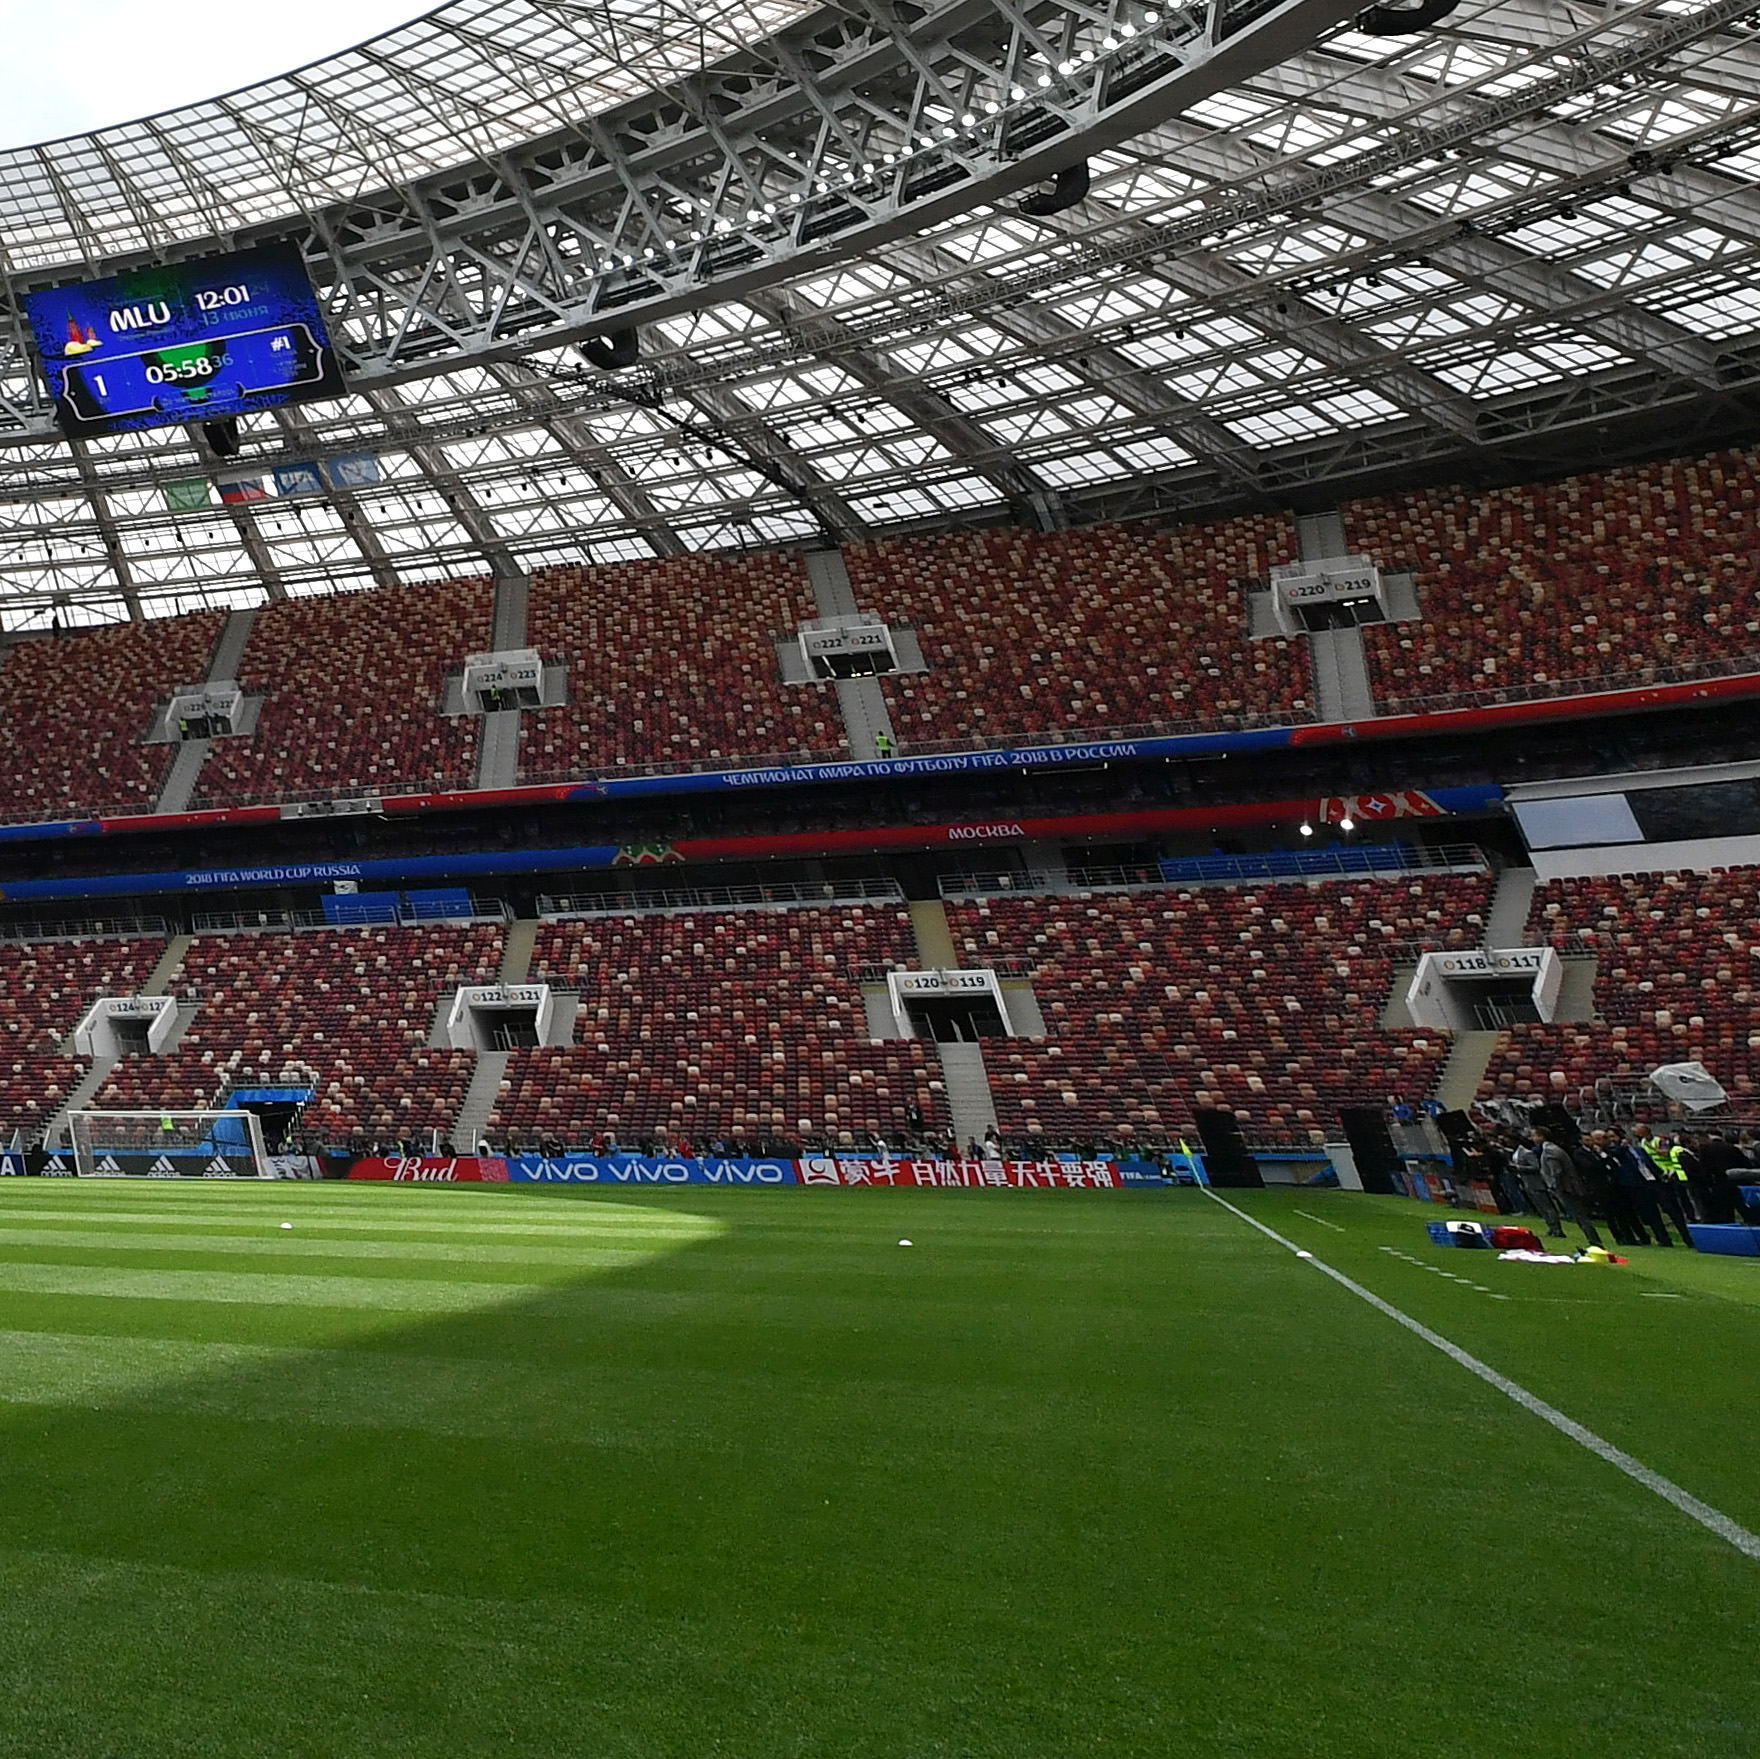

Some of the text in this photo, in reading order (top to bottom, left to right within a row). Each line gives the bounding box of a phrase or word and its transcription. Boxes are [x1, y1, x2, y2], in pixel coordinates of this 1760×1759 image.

[195, 285, 251, 311] 12:01
[109, 301, 171, 332] MLU
[201, 311, 220, 326] 13
[270, 336, 291, 351] #1
[93, 375, 108, 396] 1
[279, 470, 315, 485] FIFA
[723, 744, 1137, 786] ЧЕМПИОНАТ МИРА ПО ФУТБОЛУ FIFA 2018 В РОССИИ
[948, 823, 1025, 840] МОСКВА
[186, 864, 361, 885] 2018 FIFA WORLD CUP RUSSIA
[384, 1157, 458, 1182] Bud
[521, 1159, 598, 1181] vivo
[608, 1159, 690, 1182] vivo
[703, 1159, 783, 1184] vivo
